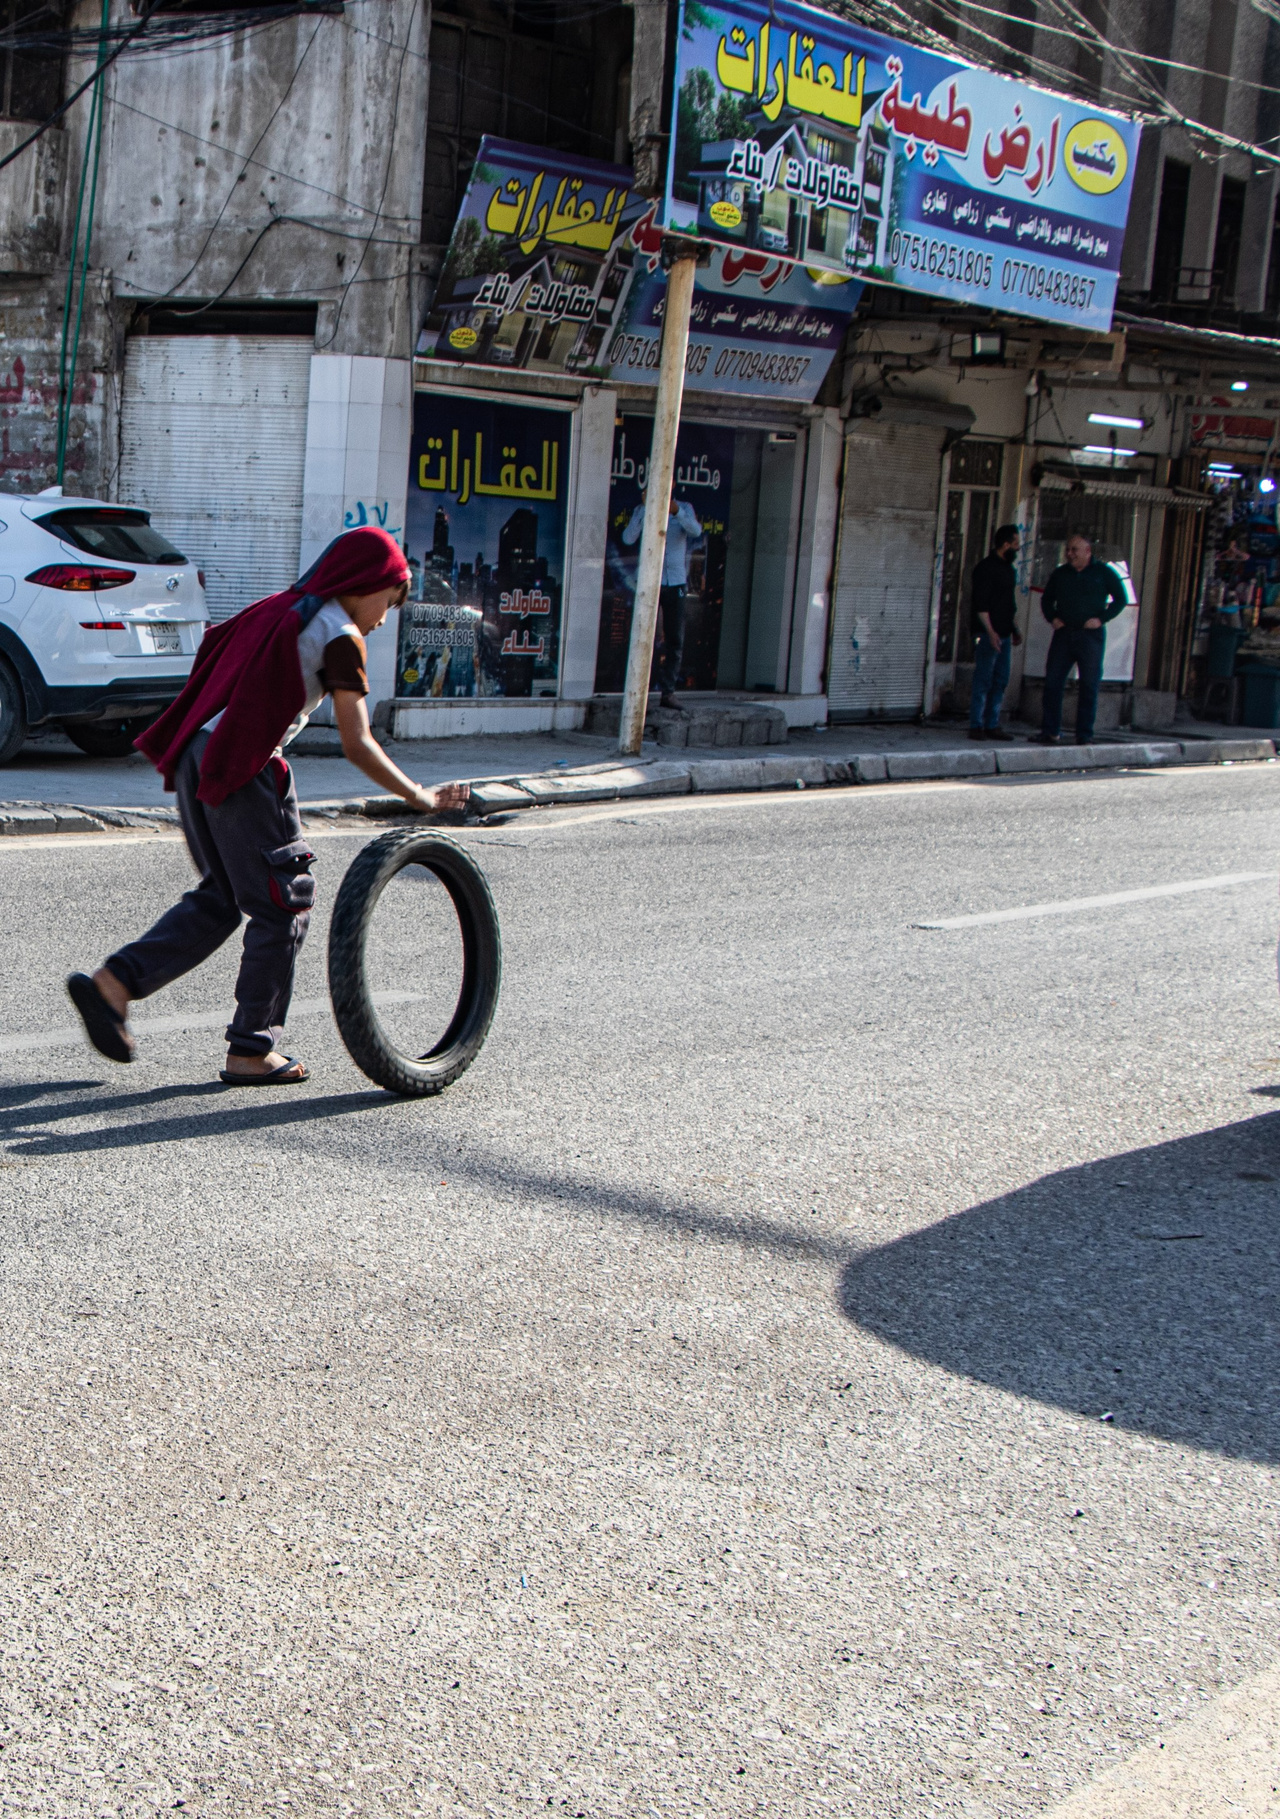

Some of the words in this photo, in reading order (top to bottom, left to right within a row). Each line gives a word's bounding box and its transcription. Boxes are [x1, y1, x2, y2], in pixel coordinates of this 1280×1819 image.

[716, 21, 866, 128] للعقارات
[879, 54, 973, 167] طيبة
[727, 138, 766, 191] بناء
[982, 101, 1063, 196] ارض
[1071, 140, 1119, 178] مكتب
[785, 158, 862, 212] مقاولات
[922, 189, 947, 215] تجاري
[486, 171, 628, 254] للعقارات
[985, 206, 1011, 233] سكني
[1052, 224, 1072, 246] الدور
[1073, 227, 1095, 254] وشراء
[1095, 240, 1110, 257] بيع
[890, 228, 993, 288] 07516251805
[1001, 260, 1097, 310] 07709483857
[473, 272, 511, 315] بناء
[526, 282, 597, 323] مقاولات
[714, 347, 811, 384] 07709483857
[418, 429, 559, 504] للعقارات
[677, 455, 721, 492] مكتب
[500, 589, 551, 619] مقاولات
[410, 628, 475, 646] 07516251805
[501, 629, 545, 661] بناء
